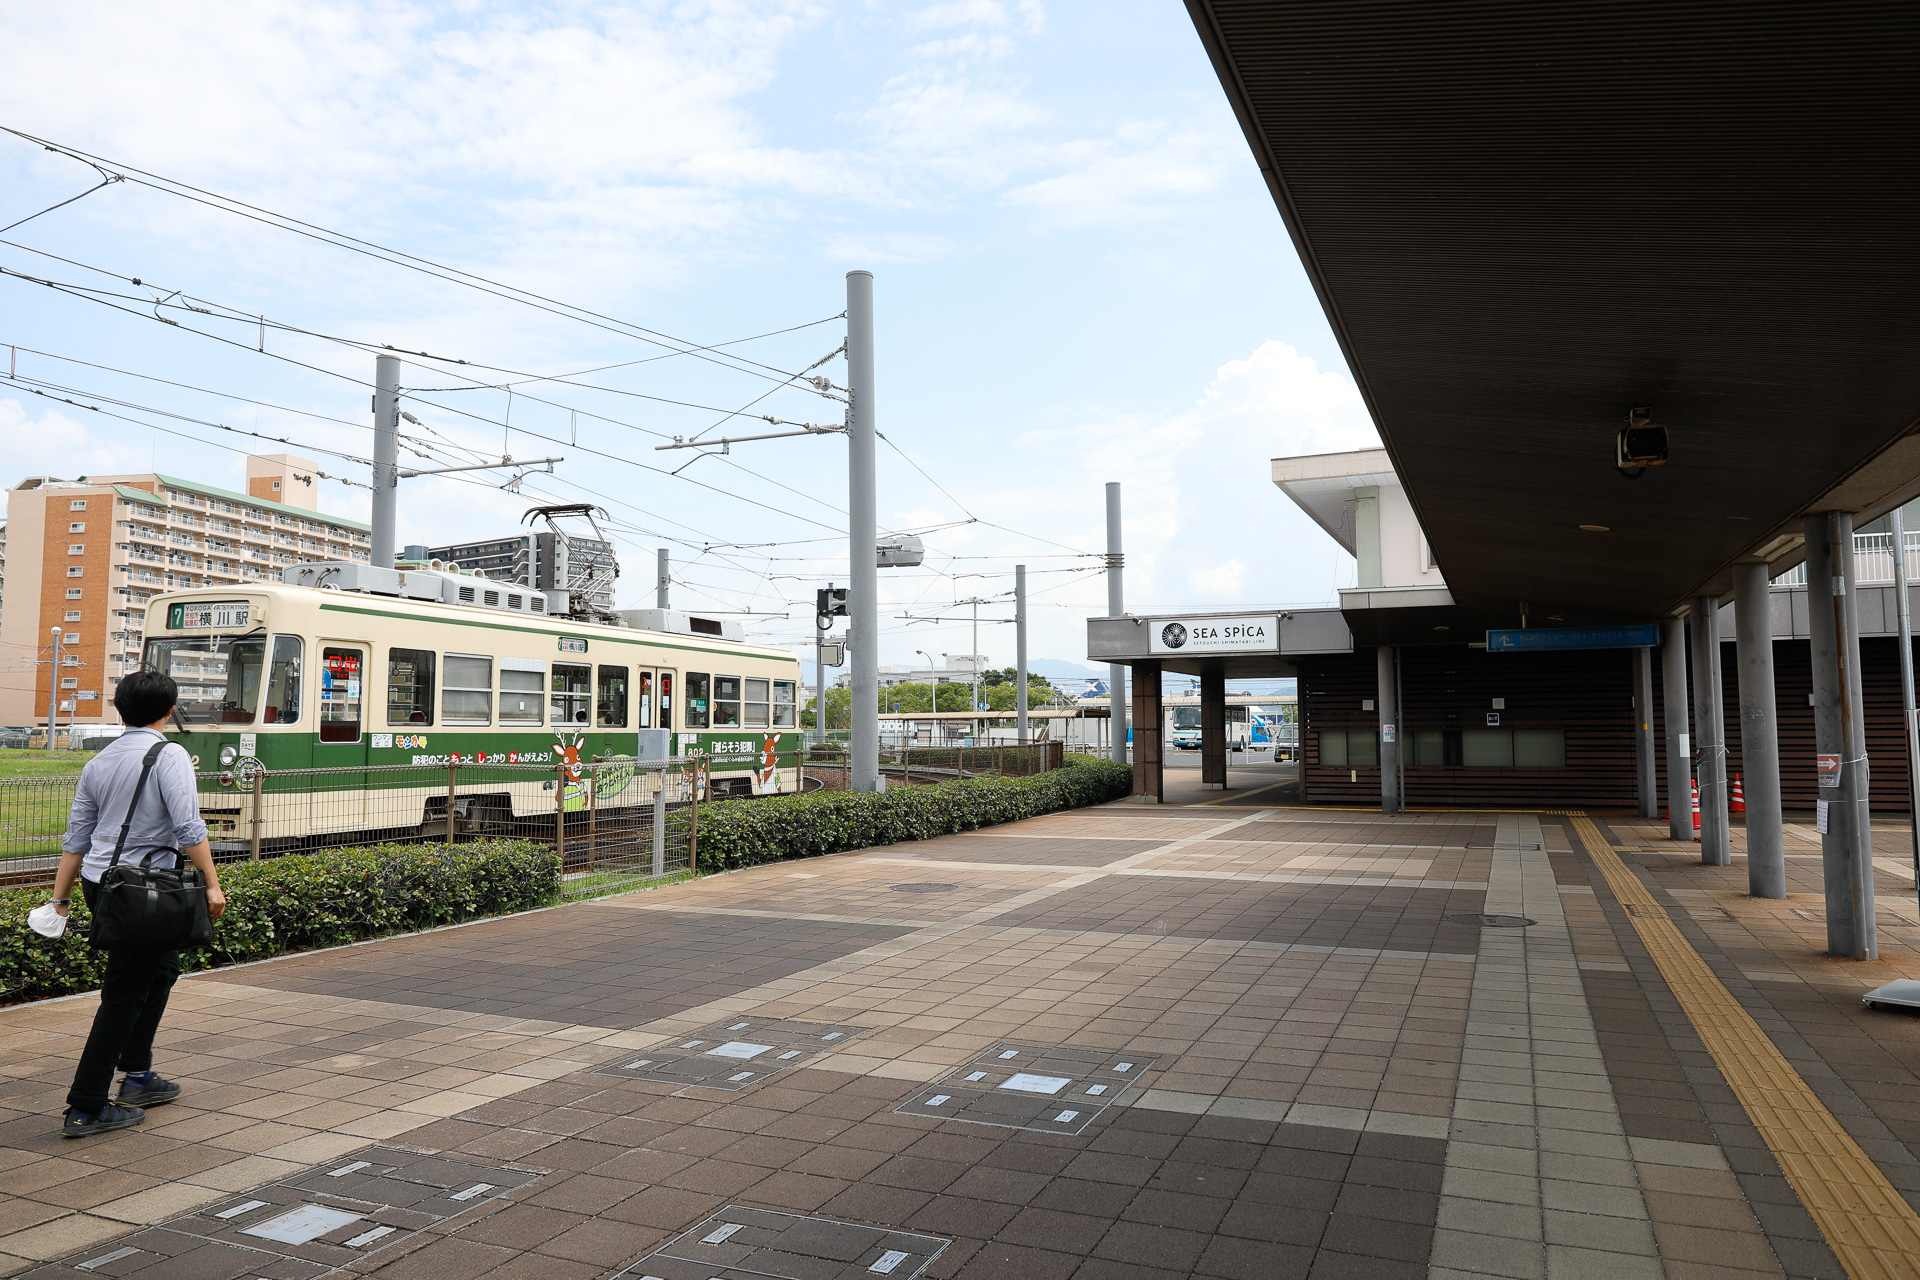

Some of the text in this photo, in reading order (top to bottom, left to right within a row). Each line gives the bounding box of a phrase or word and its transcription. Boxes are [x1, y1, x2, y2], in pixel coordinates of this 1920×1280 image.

[174, 607, 183, 626] 7
[199, 611, 249, 626] 横川駅
[1193, 628, 1218, 638] SEA
